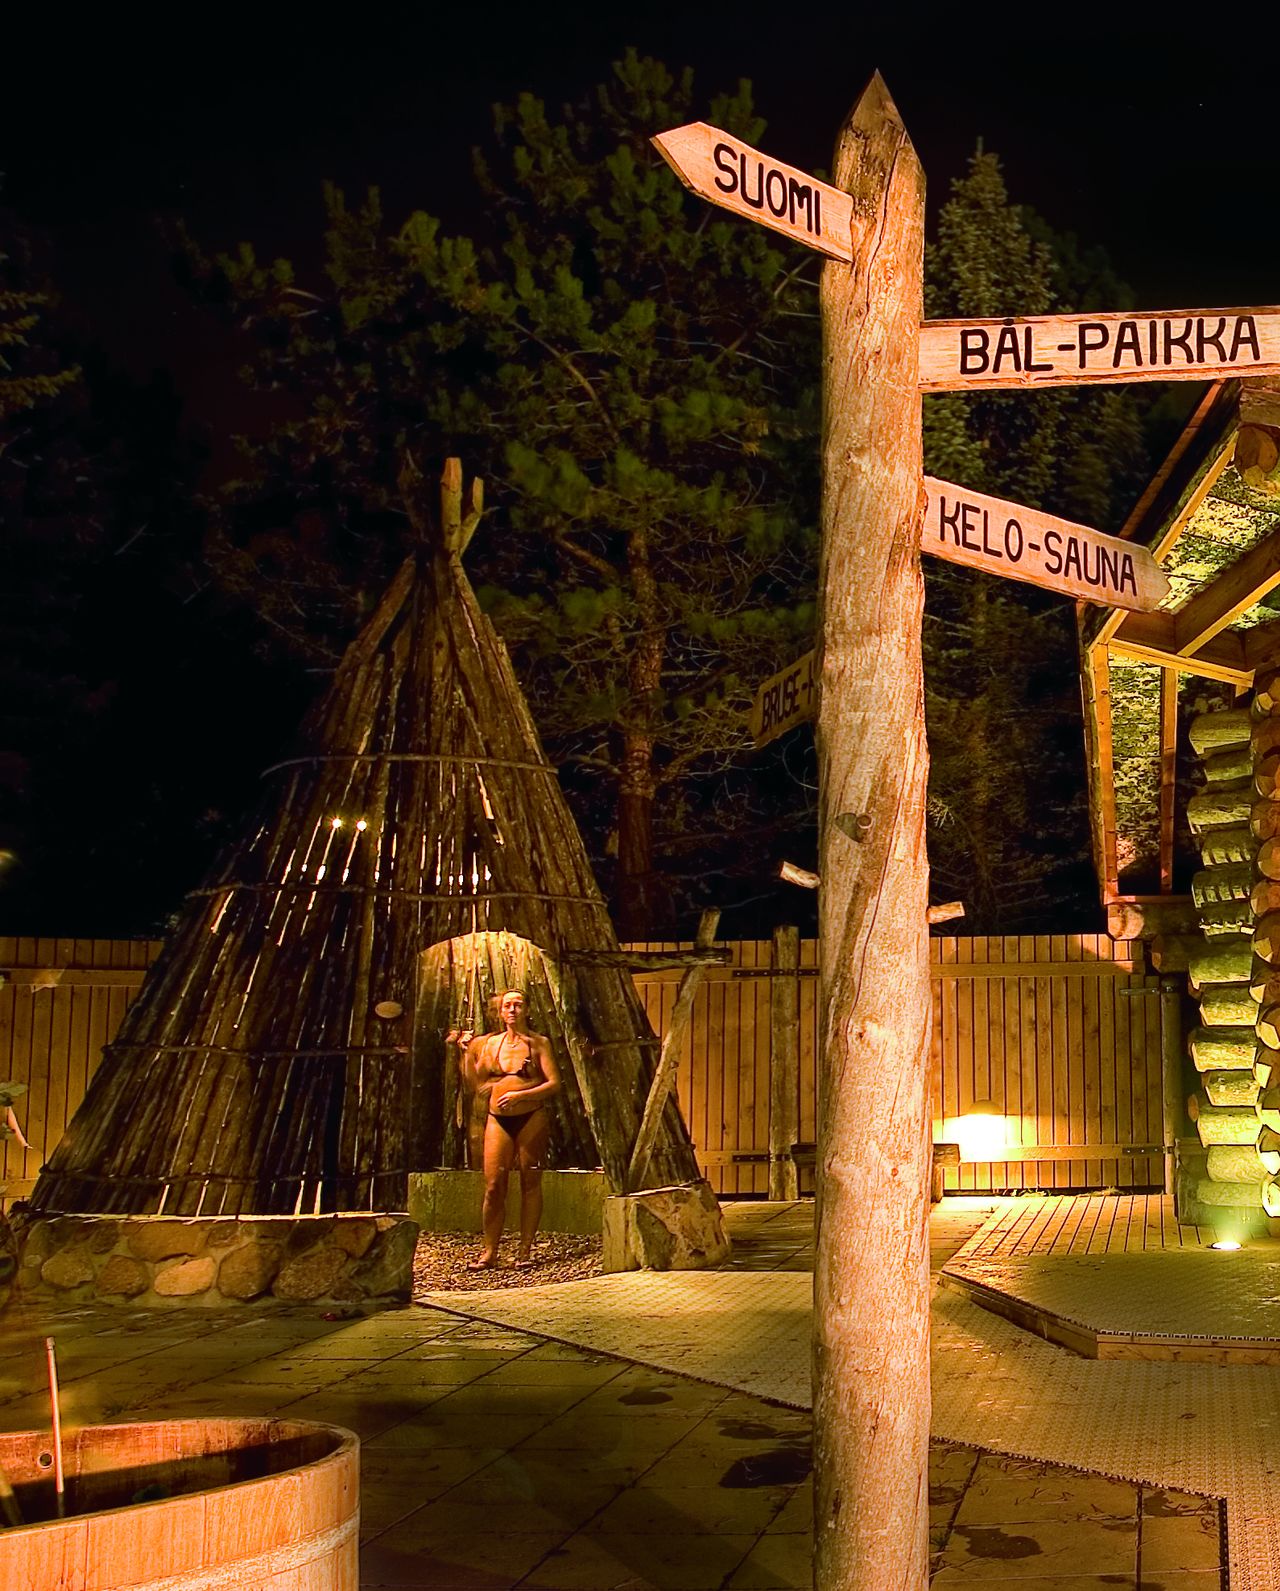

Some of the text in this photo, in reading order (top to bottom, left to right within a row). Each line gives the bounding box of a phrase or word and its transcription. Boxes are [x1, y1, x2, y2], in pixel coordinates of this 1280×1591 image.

[713, 143, 821, 236] SUOMI
[960, 316, 1260, 375] BÅL-PAIKKA
[940, 495, 1138, 596] KELO-SAUNA
